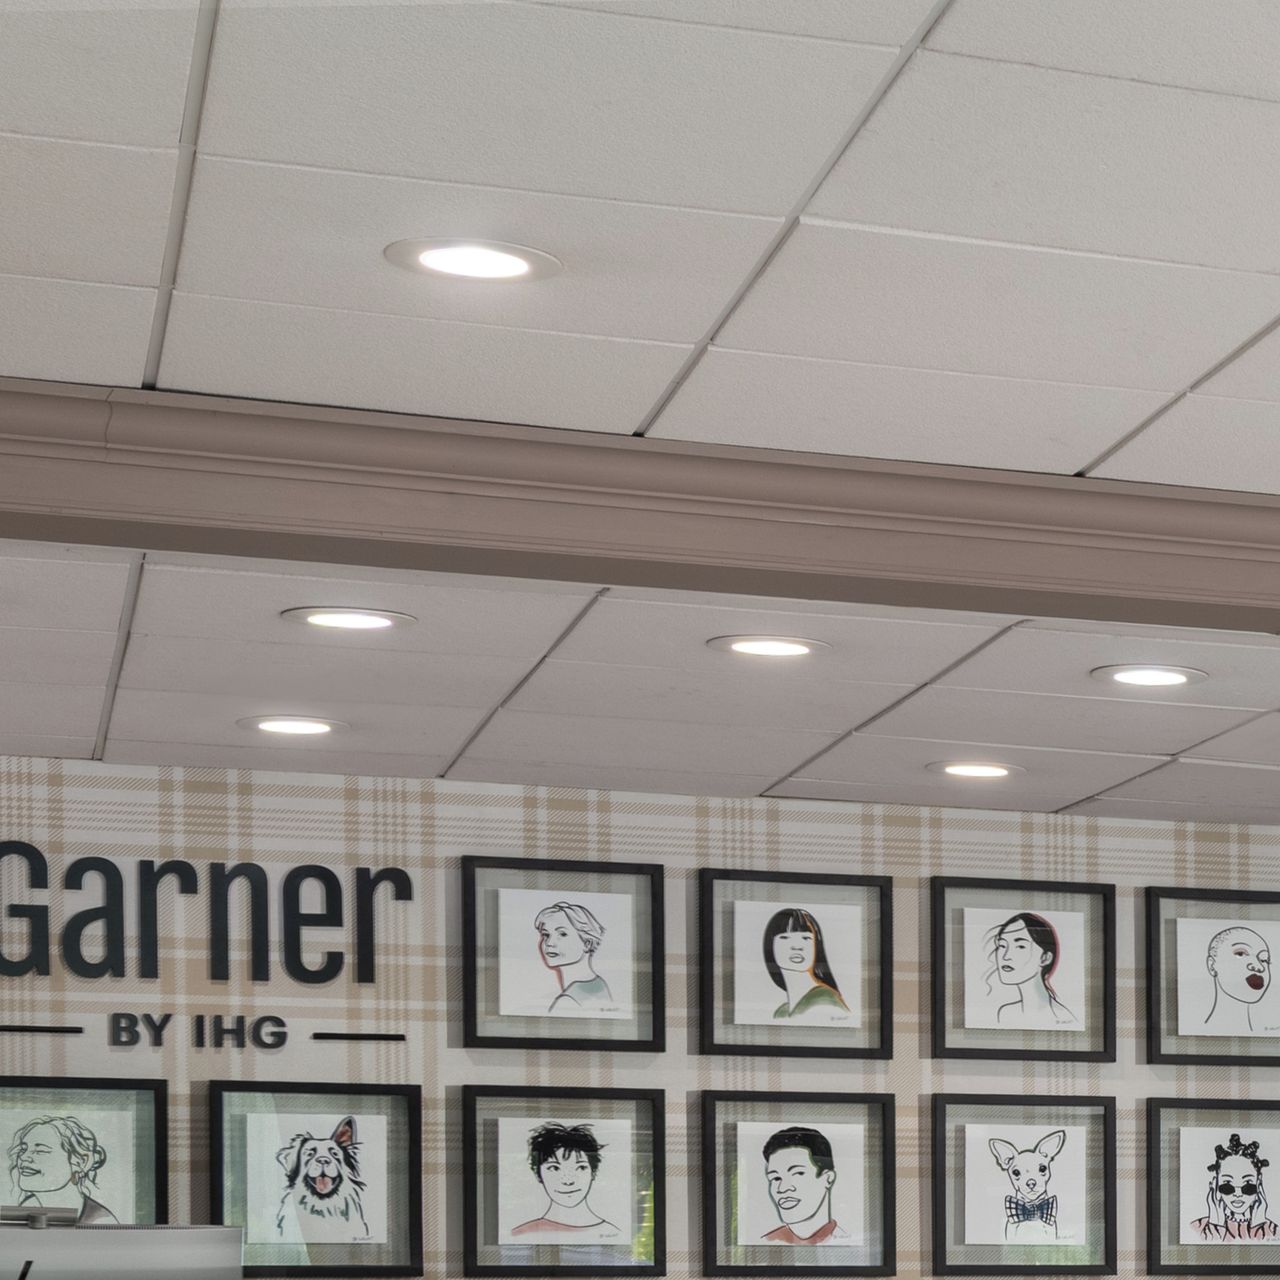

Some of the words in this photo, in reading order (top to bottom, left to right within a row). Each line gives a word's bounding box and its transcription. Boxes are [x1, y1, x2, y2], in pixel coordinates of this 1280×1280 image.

[0, 840, 413, 984] Garner
[110, 1012, 172, 1047] BY
[194, 1013, 288, 1050] IHG
